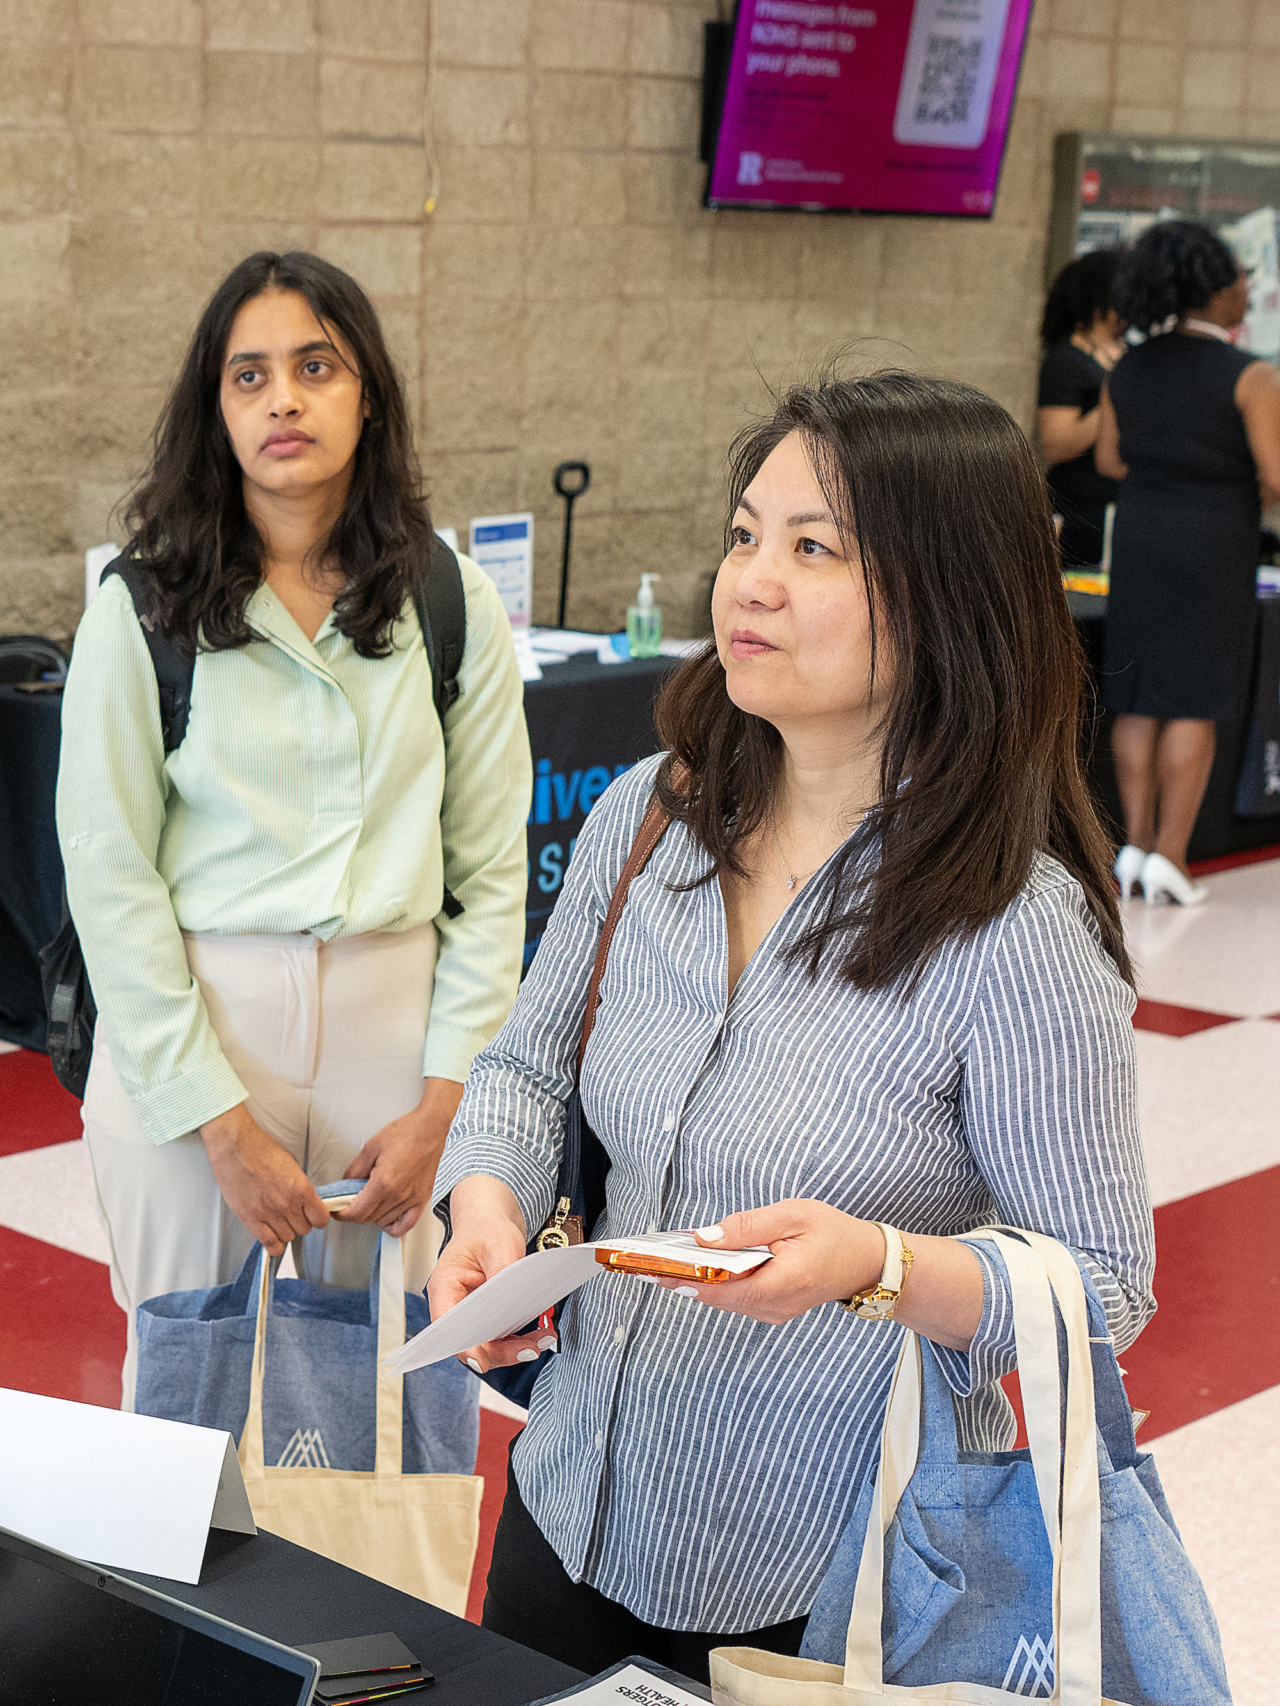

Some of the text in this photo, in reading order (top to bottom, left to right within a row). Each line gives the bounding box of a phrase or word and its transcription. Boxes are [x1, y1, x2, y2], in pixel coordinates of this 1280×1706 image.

[837, 4, 877, 28] from
[801, 29, 837, 50] sent
[837, 32, 857, 52] to
[746, 52, 785, 75] your
[635, 1684, 680, 1706] HEALTH
